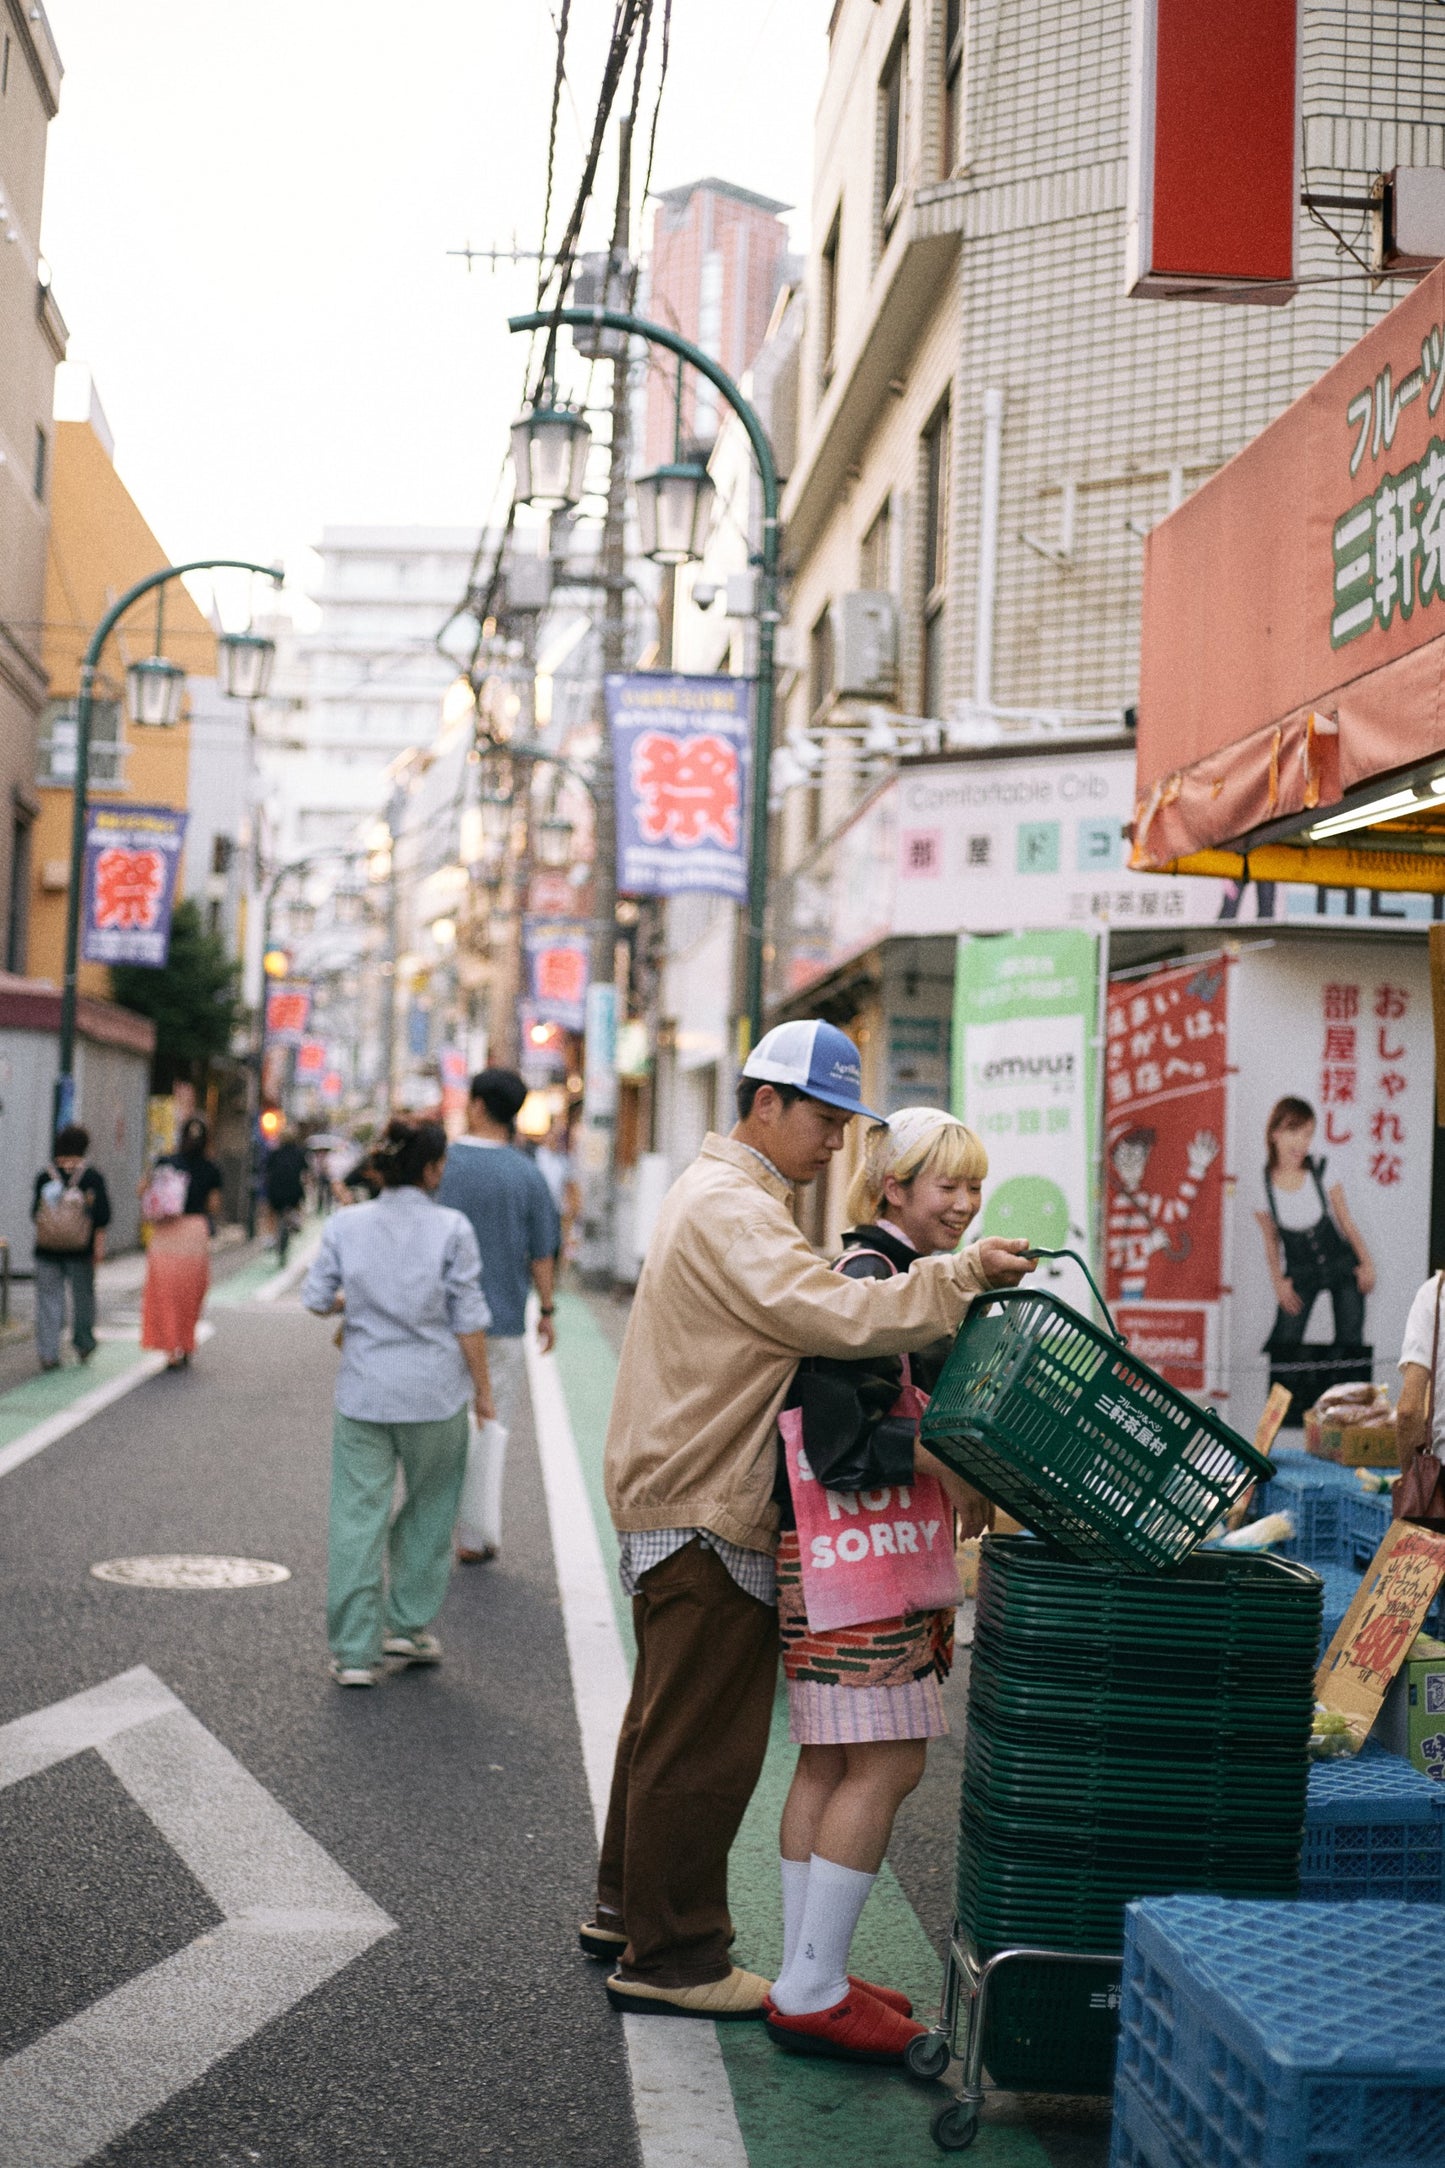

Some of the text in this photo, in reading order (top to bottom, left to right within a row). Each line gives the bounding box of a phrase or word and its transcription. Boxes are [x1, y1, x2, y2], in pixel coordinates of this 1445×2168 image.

[1322, 982, 1359, 1145] 部屋探し
[1370, 982, 1410, 1187] おしゃれな
[1094, 1394, 1168, 1457] 三軒茶屋村
[1117, 1395, 1164, 1433] フルーツ&ベジ
[826, 1485, 912, 1521] NOT
[810, 1519, 941, 1569] SORRY
